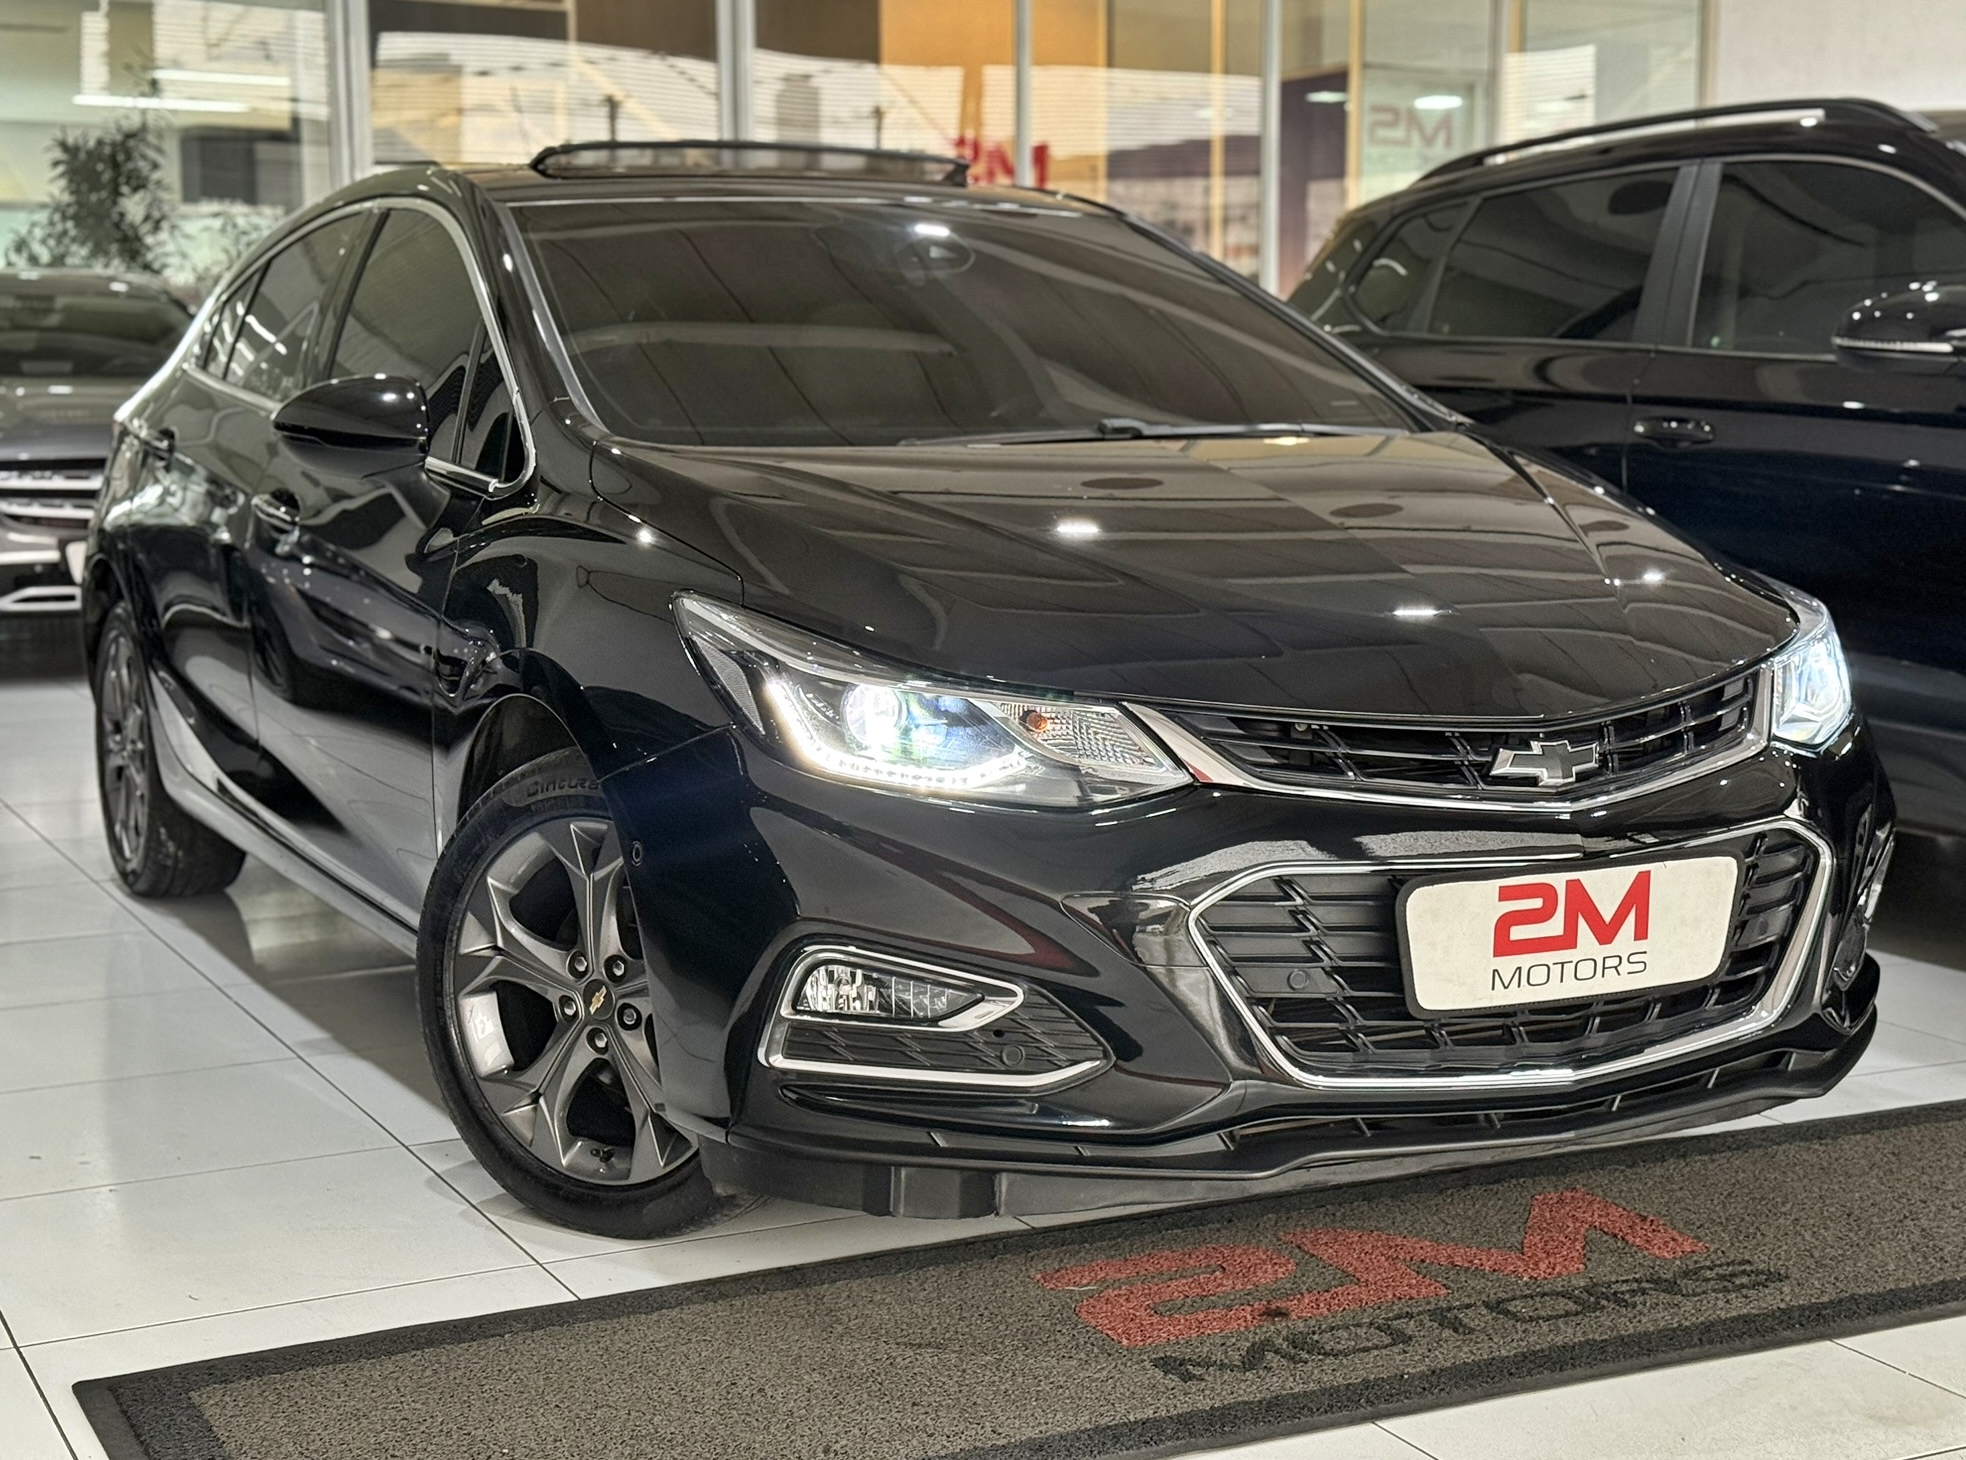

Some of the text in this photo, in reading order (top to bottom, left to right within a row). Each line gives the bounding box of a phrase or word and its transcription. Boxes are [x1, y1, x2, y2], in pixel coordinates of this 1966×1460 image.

[1368, 104, 1452, 150] 2M
[1493, 870, 1651, 958] 2M
[1491, 951, 1648, 991] MOTORS
[1033, 1187, 1709, 1347] 2M
[1153, 1259, 1782, 1381] MOTORS
